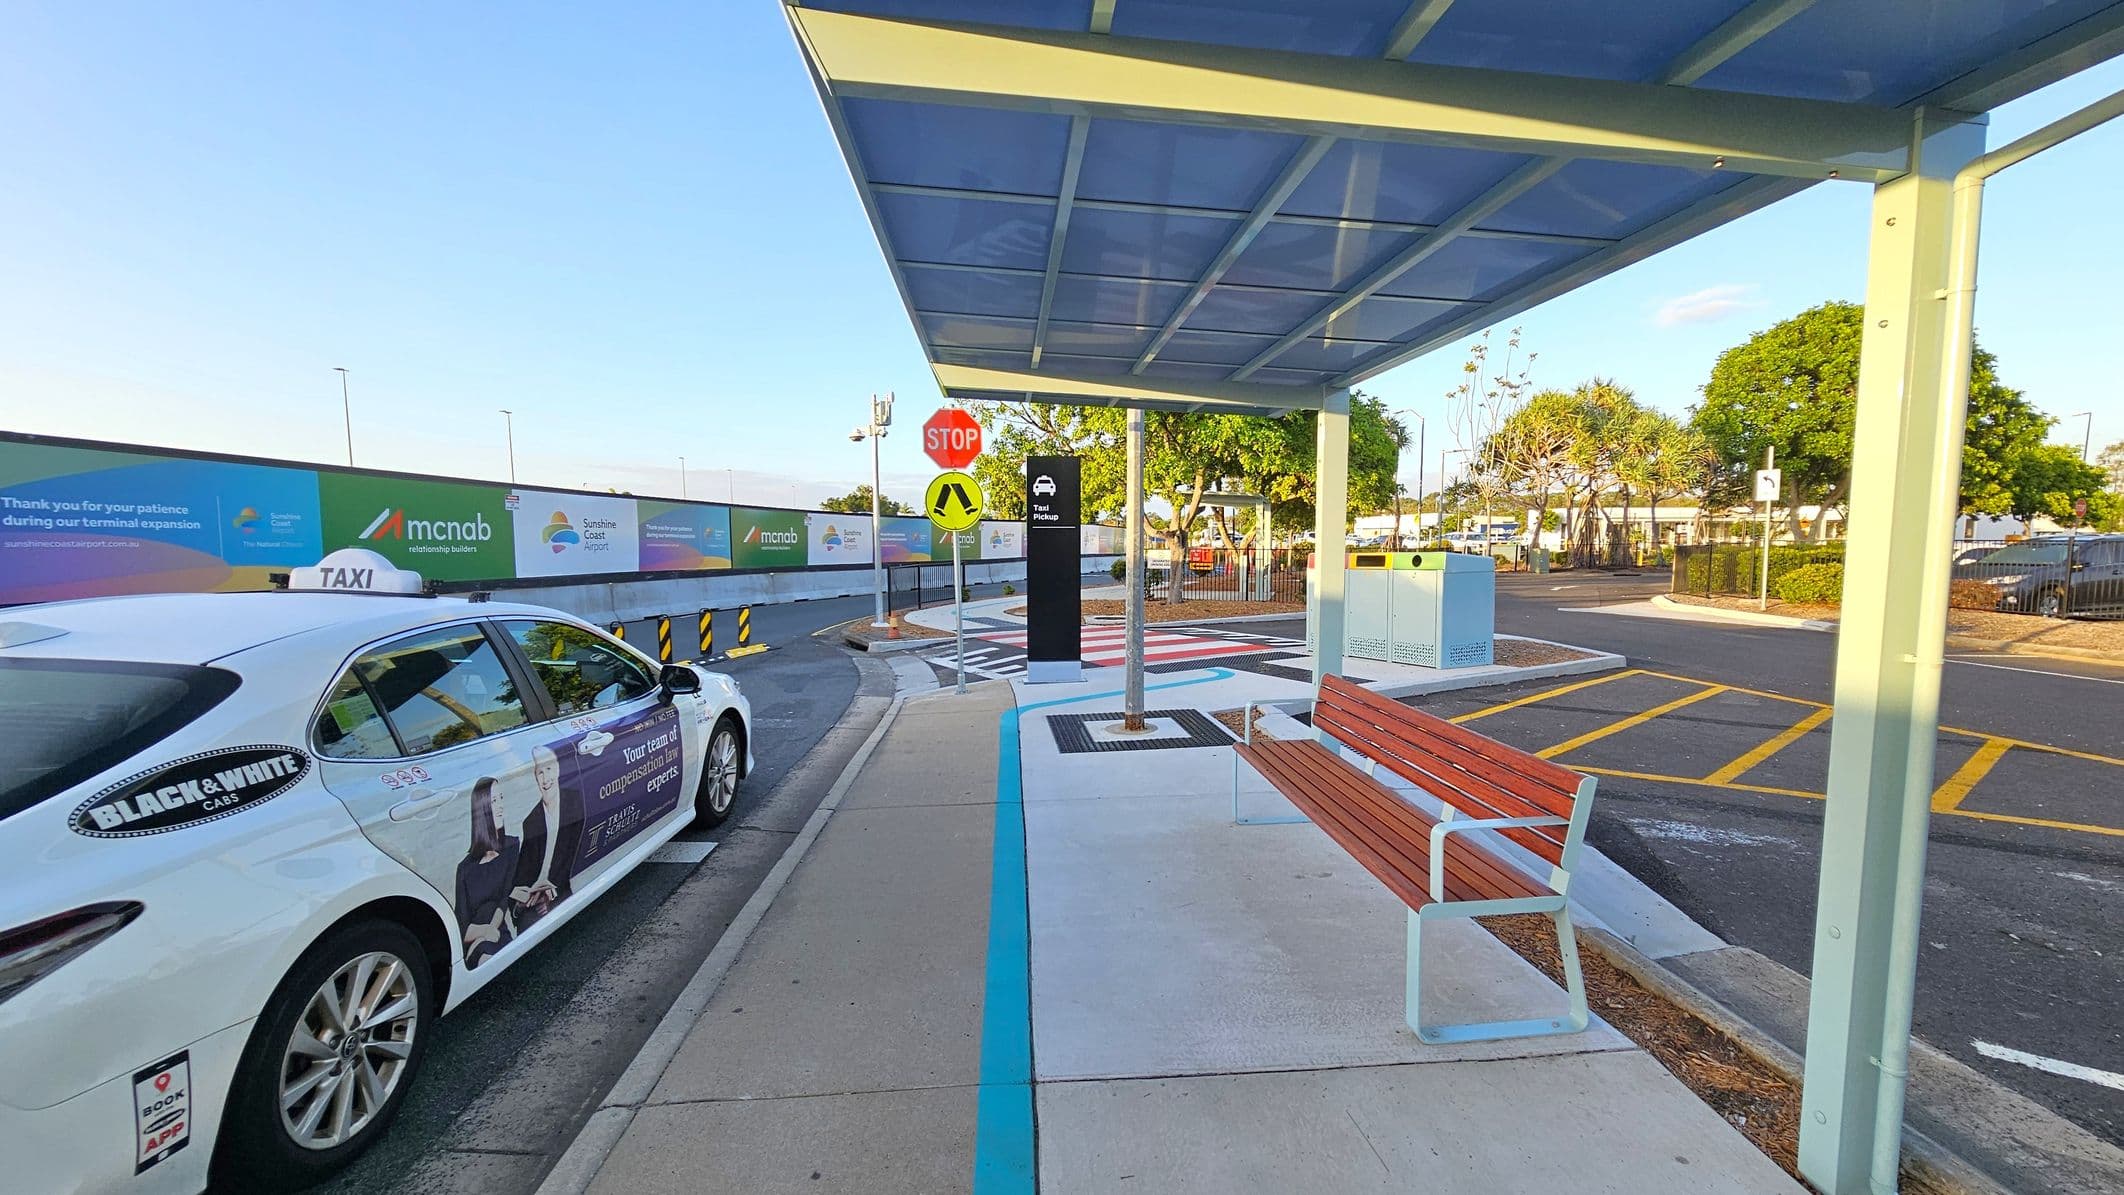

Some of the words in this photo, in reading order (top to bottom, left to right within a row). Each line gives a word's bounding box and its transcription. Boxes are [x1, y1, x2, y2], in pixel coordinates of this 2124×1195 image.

[927, 428, 978, 450] STOP
[1, 497, 50, 509] Thank
[52, 501, 80, 513] you
[82, 500, 102, 511] for
[104, 504, 134, 515] your
[137, 504, 189, 515] patience
[2, 515, 53, 529] during
[56, 519, 80, 528] our
[82, 517, 139, 528] terminal
[141, 519, 201, 530] expansion
[583, 518, 616, 529] Sunshine
[1033, 513, 1059, 521] Pickup
[408, 513, 491, 541] mcnab
[584, 530, 605, 540] Coast
[761, 527, 798, 544] mcnab
[5, 539, 139, 549] sunshinecoastairport.com.au
[409, 545, 450, 554] relationship
[451, 545, 477, 553] builders
[584, 542, 609, 552] Airport
[320, 567, 373, 589] TAXI
[666, 709, 676, 719] FEE
[623, 743, 647, 765] Your
[647, 735, 668, 752] team
[669, 725, 678, 742] of
[600, 755, 664, 799] compensation
[665, 747, 679, 764] law
[647, 766, 679, 793] experts.
[202, 793, 239, 811] CABS
[605, 809, 640, 838] SCHULTZ
[608, 803, 635, 826] TRAVIS
[143, 1088, 185, 1117] BOOK
[144, 1121, 184, 1155] APP
